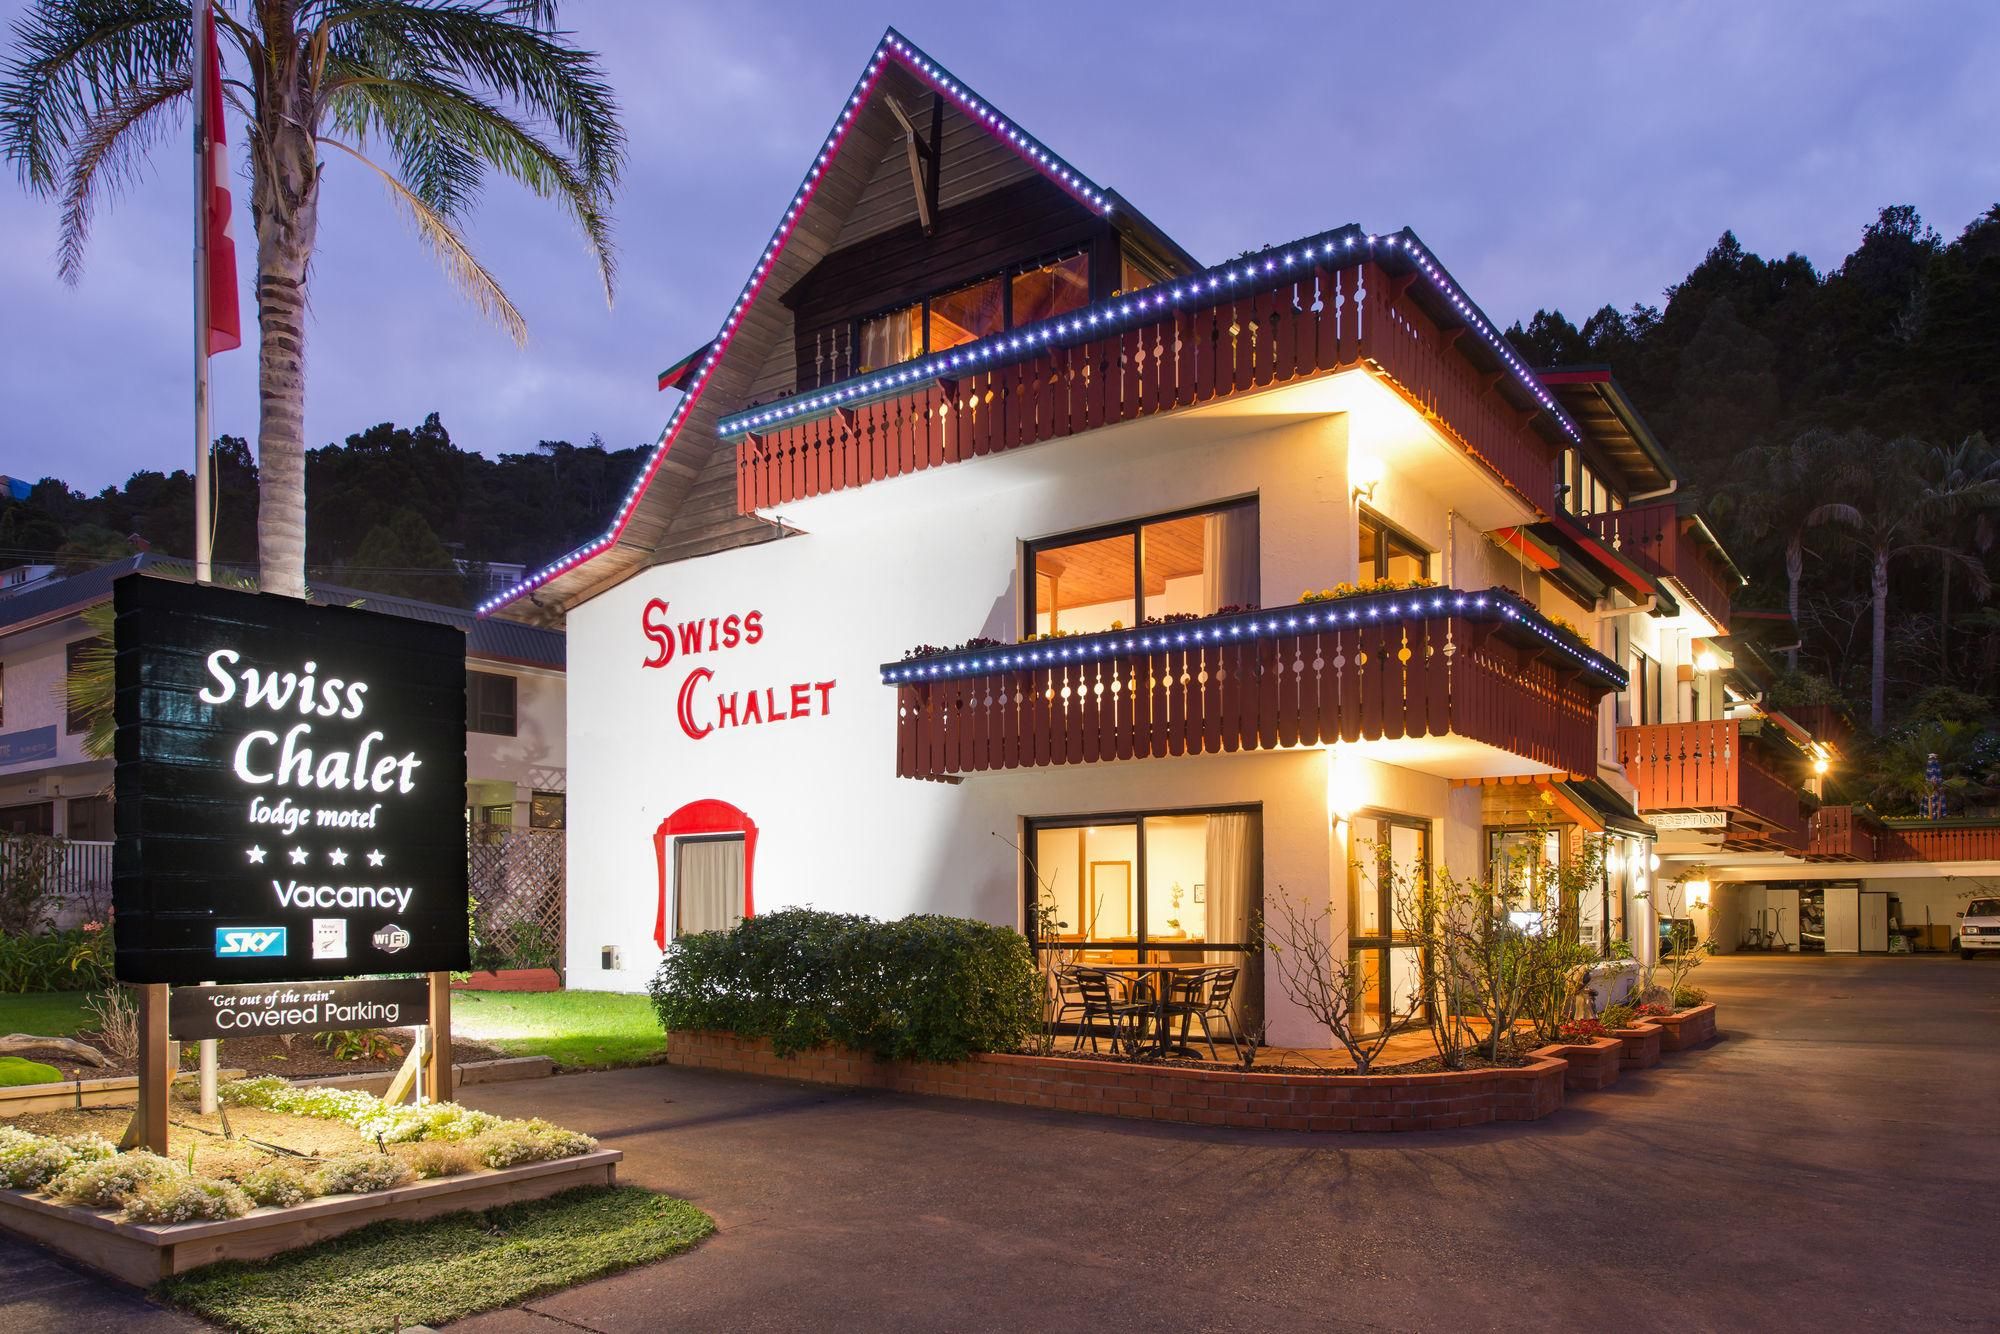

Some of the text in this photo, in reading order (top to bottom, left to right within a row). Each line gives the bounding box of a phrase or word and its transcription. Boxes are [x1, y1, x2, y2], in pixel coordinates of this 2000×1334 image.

[642, 597, 763, 669] SWISS
[199, 649, 368, 719] Swiss
[677, 666, 836, 740] CHALET
[234, 723, 422, 793] Chalet
[250, 796, 381, 835] lodge motel
[1648, 813, 1723, 827] RECEPTION
[272, 880, 413, 912] Vacancy
[220, 932, 280, 953] SKY
[215, 1001, 399, 1029] Covered Parking
[240, 994, 261, 1006] out
[264, 990, 280, 1010] of
[281, 989, 300, 1004] the
